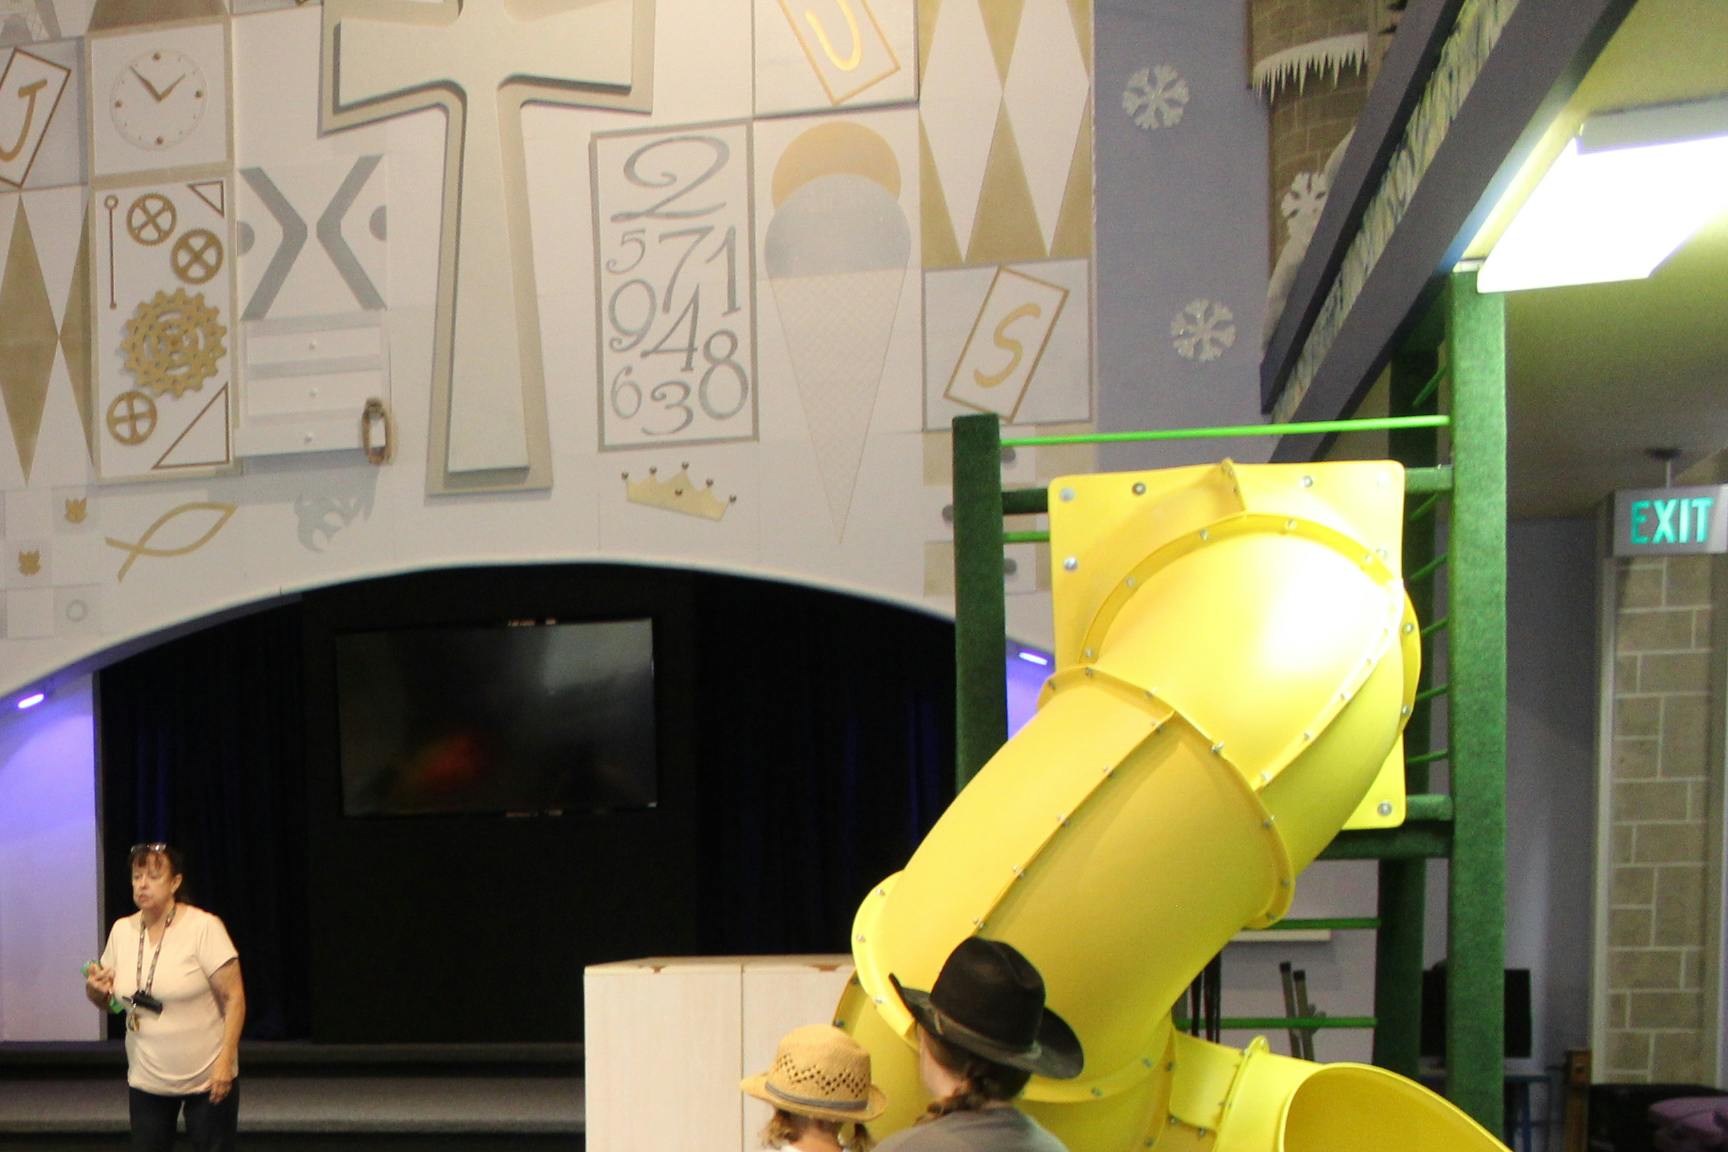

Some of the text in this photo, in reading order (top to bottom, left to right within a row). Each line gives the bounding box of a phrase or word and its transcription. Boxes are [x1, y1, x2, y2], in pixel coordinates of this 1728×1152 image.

[610, 135, 730, 223] 2
[974, 304, 1041, 388] S
[1631, 496, 1714, 544] EXIT
